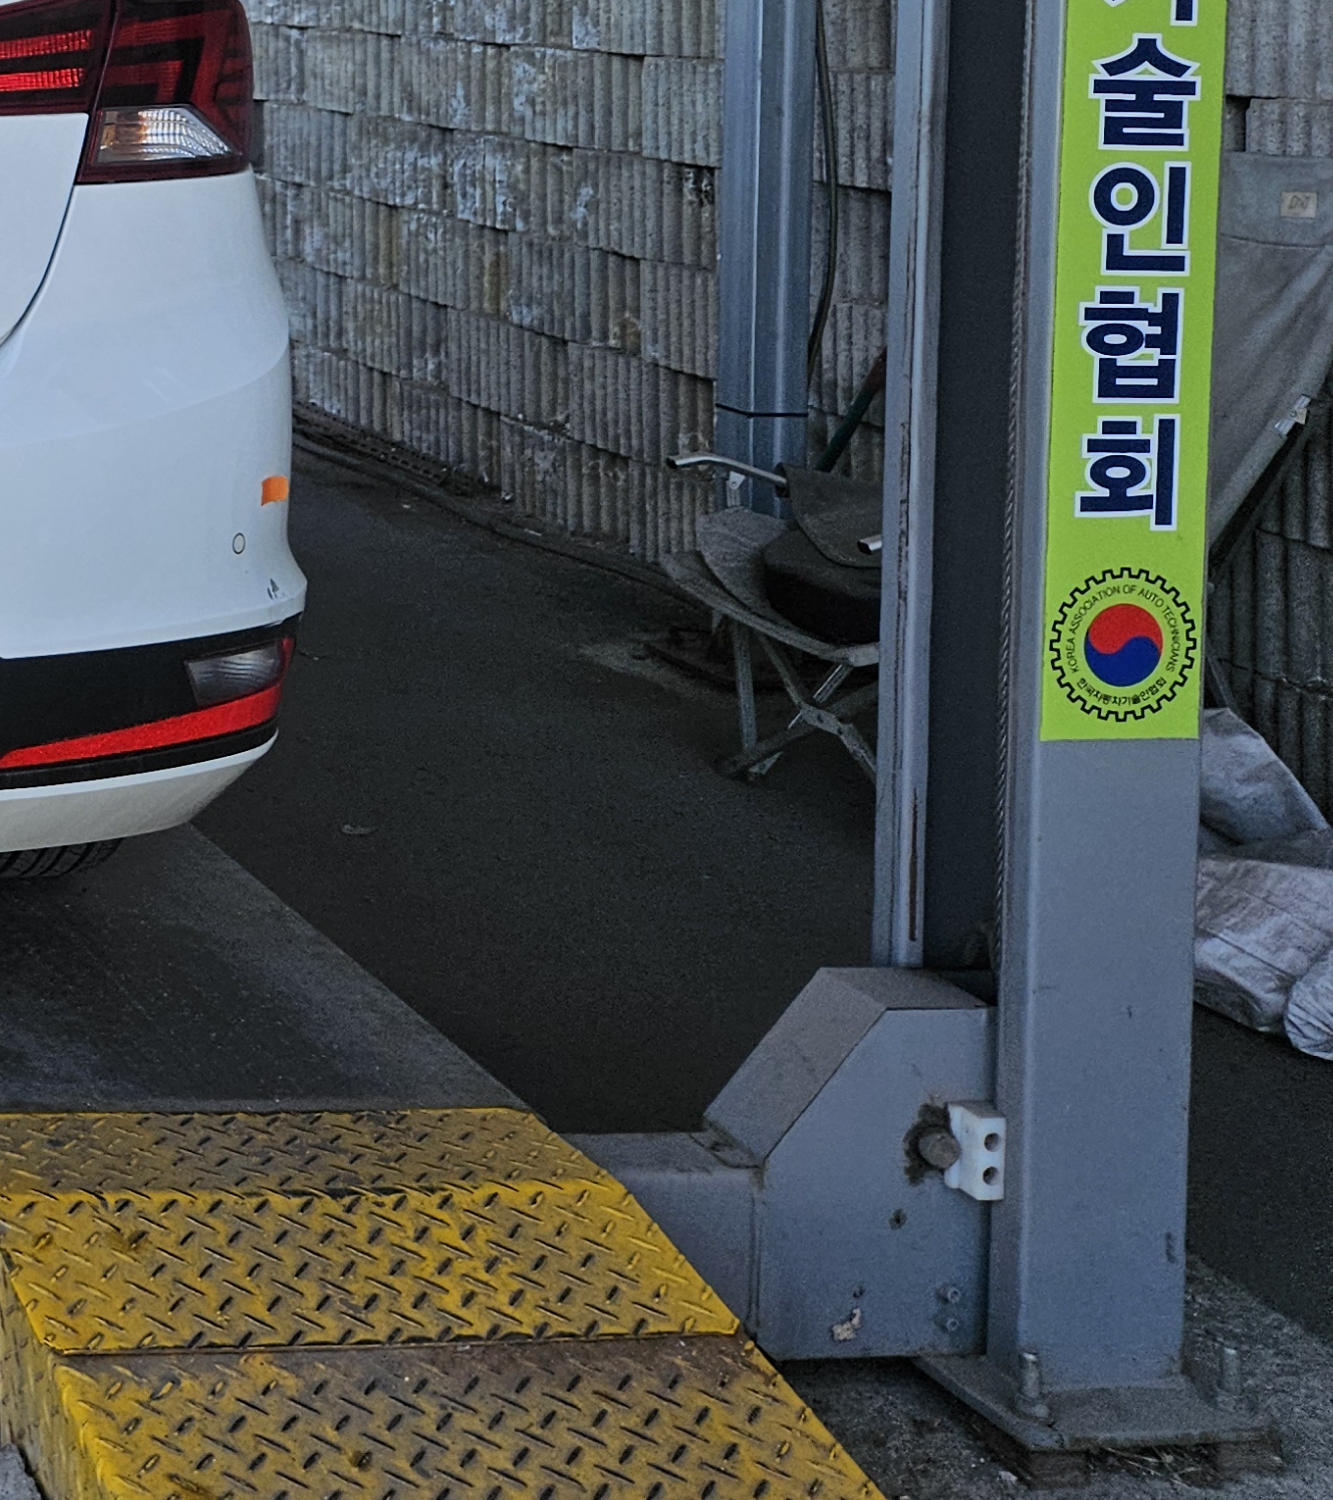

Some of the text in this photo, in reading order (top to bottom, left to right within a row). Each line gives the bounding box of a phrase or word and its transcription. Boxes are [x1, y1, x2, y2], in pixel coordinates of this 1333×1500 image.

[1066, 584, 1181, 674] KOREA ASSOCIATION OF AUTO TECHNICIANS
